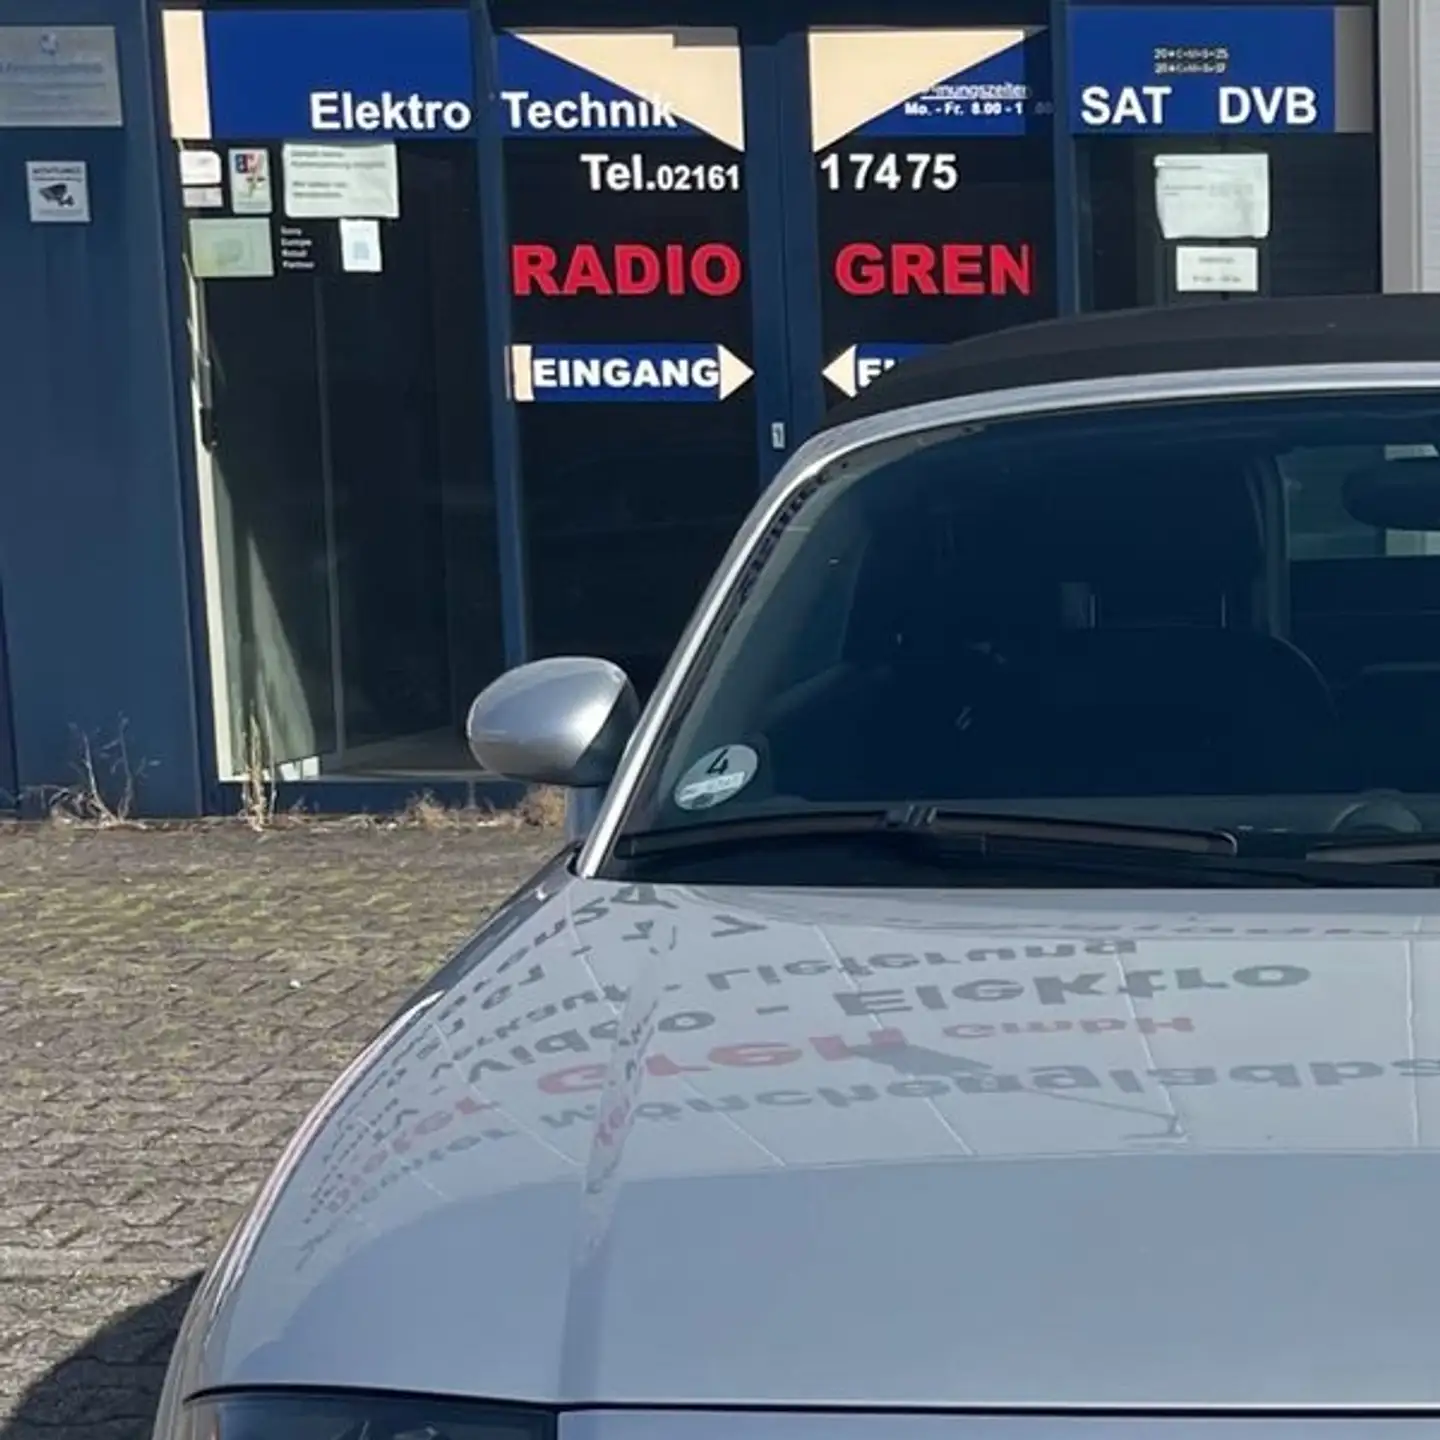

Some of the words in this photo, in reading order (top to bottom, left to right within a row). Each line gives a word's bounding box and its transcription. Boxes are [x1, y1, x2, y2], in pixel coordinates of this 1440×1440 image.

[310, 91, 472, 131] Elektro
[500, 91, 678, 129] Technik
[904, 101, 932, 116] Mo.
[944, 101, 964, 116] Fr.
[971, 101, 1002, 116] 8.00
[1080, 86, 1173, 125] SAT
[1218, 86, 1317, 125] DVB
[819, 152, 959, 191] 17475
[511, 242, 742, 297] RADIO
[835, 242, 1031, 296] GREN
[532, 357, 720, 389] EINGANG
